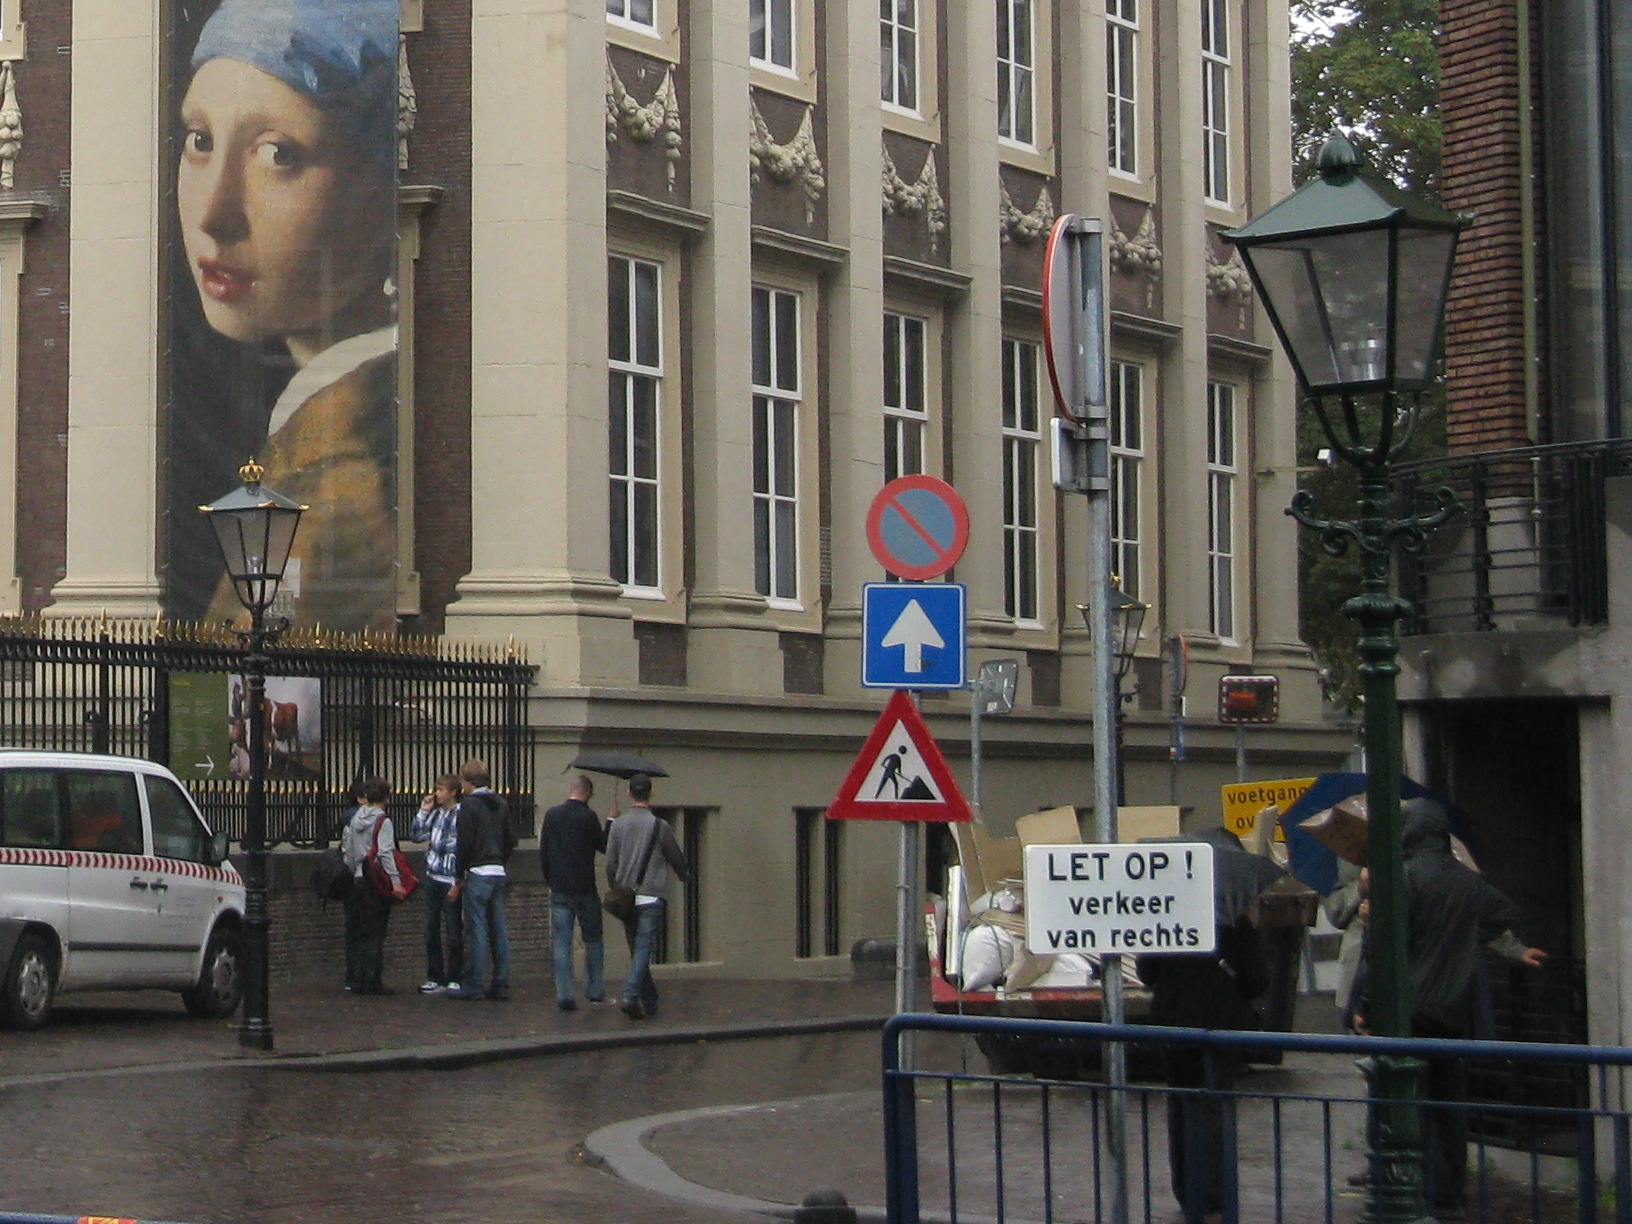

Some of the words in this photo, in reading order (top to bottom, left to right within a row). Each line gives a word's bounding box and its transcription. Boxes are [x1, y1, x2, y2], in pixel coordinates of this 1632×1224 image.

[1047, 852, 1111, 881] LET
[1124, 851, 1170, 880] OP
[1184, 850, 1193, 880] !
[1068, 889, 1176, 915] verkeer
[1046, 928, 1097, 948] van
[1110, 922, 1199, 947] rechts
